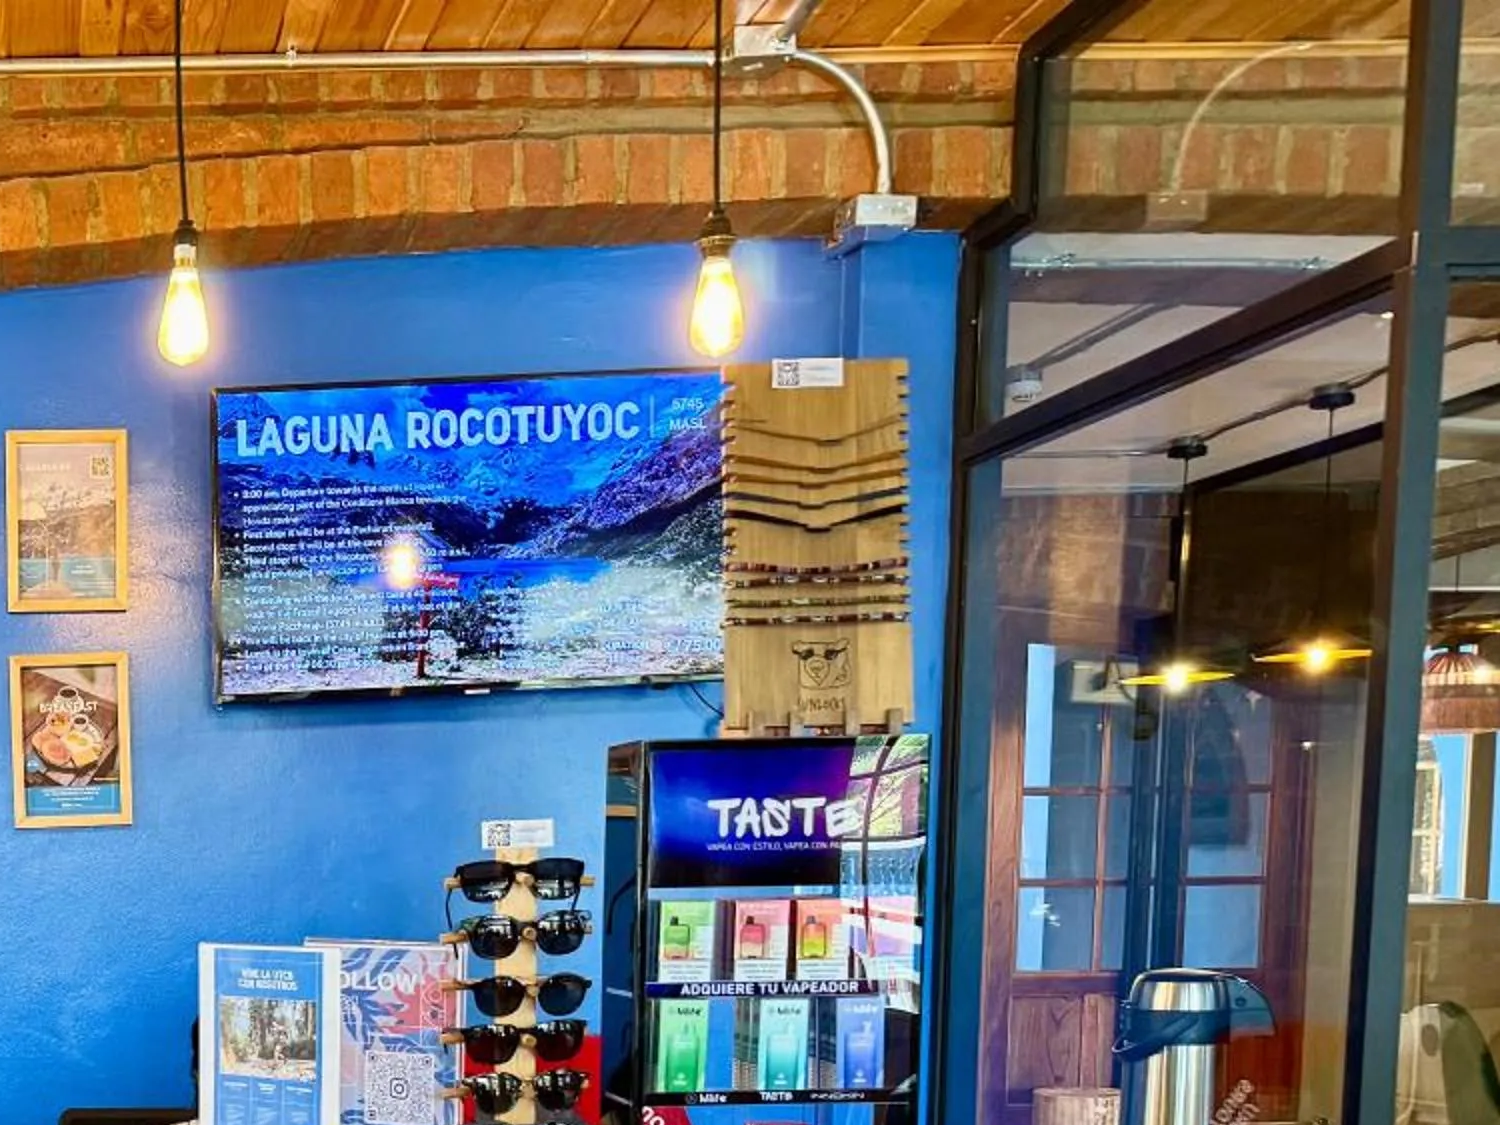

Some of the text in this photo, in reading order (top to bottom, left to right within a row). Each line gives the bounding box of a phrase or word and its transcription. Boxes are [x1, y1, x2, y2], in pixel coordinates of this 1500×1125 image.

[235, 400, 640, 457] LAGUNA ROCOTUYOC
[39, 700, 99, 713] BREAKFAST
[707, 796, 862, 838] TASTE
[340, 969, 419, 994] OLLOW
[680, 980, 859, 996] ADQUIERE TU VAPEADOR
